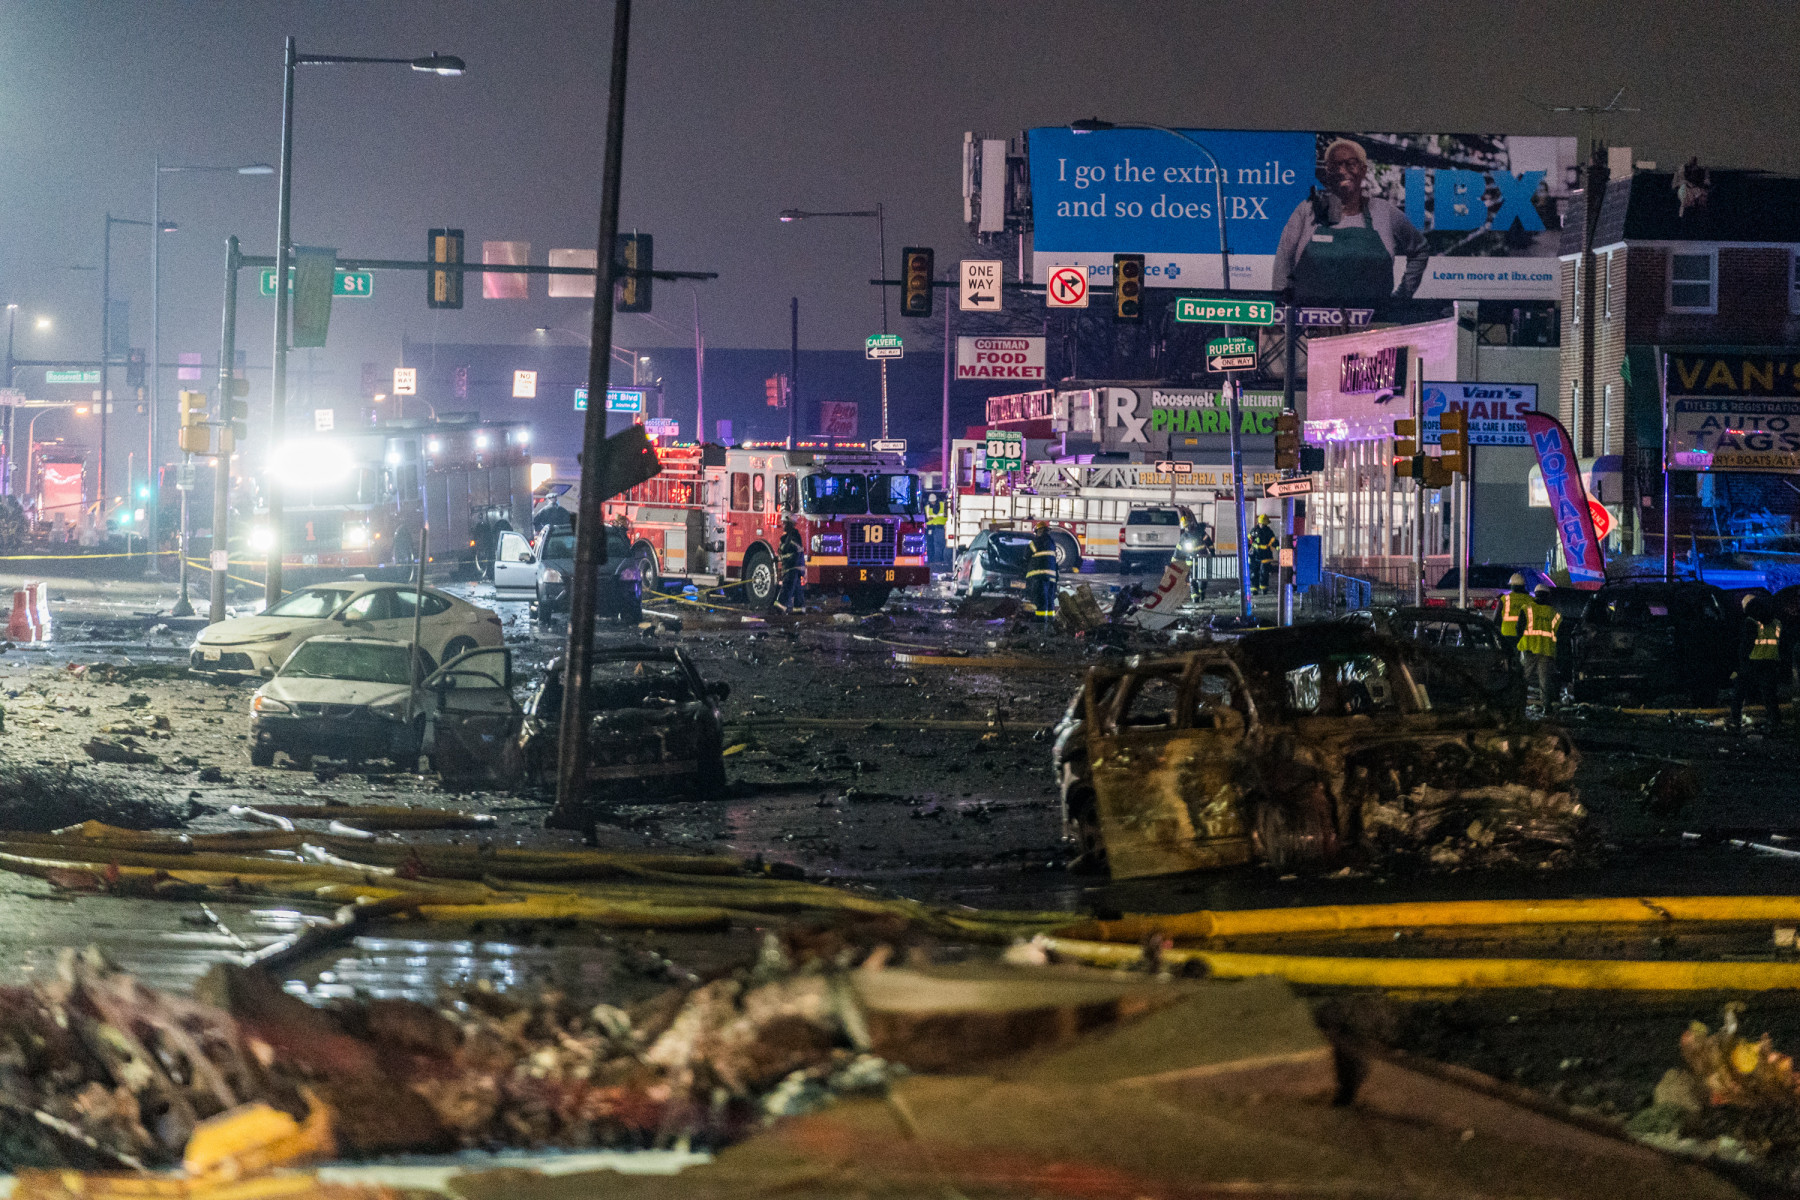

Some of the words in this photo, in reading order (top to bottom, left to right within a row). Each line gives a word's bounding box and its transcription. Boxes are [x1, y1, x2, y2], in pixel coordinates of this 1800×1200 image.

[1058, 158, 1067, 182] I
[1074, 165, 1105, 189] go
[1114, 158, 1156, 183] the
[1163, 163, 1229, 184] extra
[1238, 160, 1295, 185] mile
[1057, 193, 1106, 217] and
[1114, 201, 1143, 218] so
[1150, 194, 1211, 219] does
[1405, 169, 1548, 231] IBX
[968, 265, 994, 277] ONE
[1433, 271, 1464, 280] Learn
[1467, 273, 1495, 281] more
[1498, 272, 1508, 281] at
[1511, 271, 1553, 281] ibx.com
[344, 275, 365, 291] St
[968, 278, 994, 290] WAY
[1184, 303, 1241, 319] Rupert
[1249, 305, 1266, 319] St
[867, 338, 897, 346] CALVERT
[977, 340, 1026, 350] COTTMAN
[1209, 343, 1246, 355] RUPERT
[976, 353, 1027, 364] FOOD
[959, 365, 1044, 377] MARKET
[1152, 391, 1214, 407] Roosevelt
[1463, 386, 1523, 399] Van's
[1243, 394, 1283, 407] DELIVERY
[1684, 401, 1718, 411] TITLES
[1449, 401, 1531, 420] NAILS
[1482, 422, 1499, 432] CARE
[1700, 415, 1790, 431] AUTO
[1688, 431, 1800, 452] TAGS
[993, 443, 998, 454] 1
[1010, 444, 1014, 455] 1
[1139, 472, 1217, 485] PHILAELPHIA
[1222, 473, 1247, 485] FIE
[1278, 484, 1293, 492] ONE
[1295, 482, 1308, 490] WAY
[1590, 507, 1606, 527] ENTE
[305, 521, 316, 541] 1
[863, 525, 883, 543] 18
[860, 569, 867, 581] E
[885, 570, 895, 581] 18
